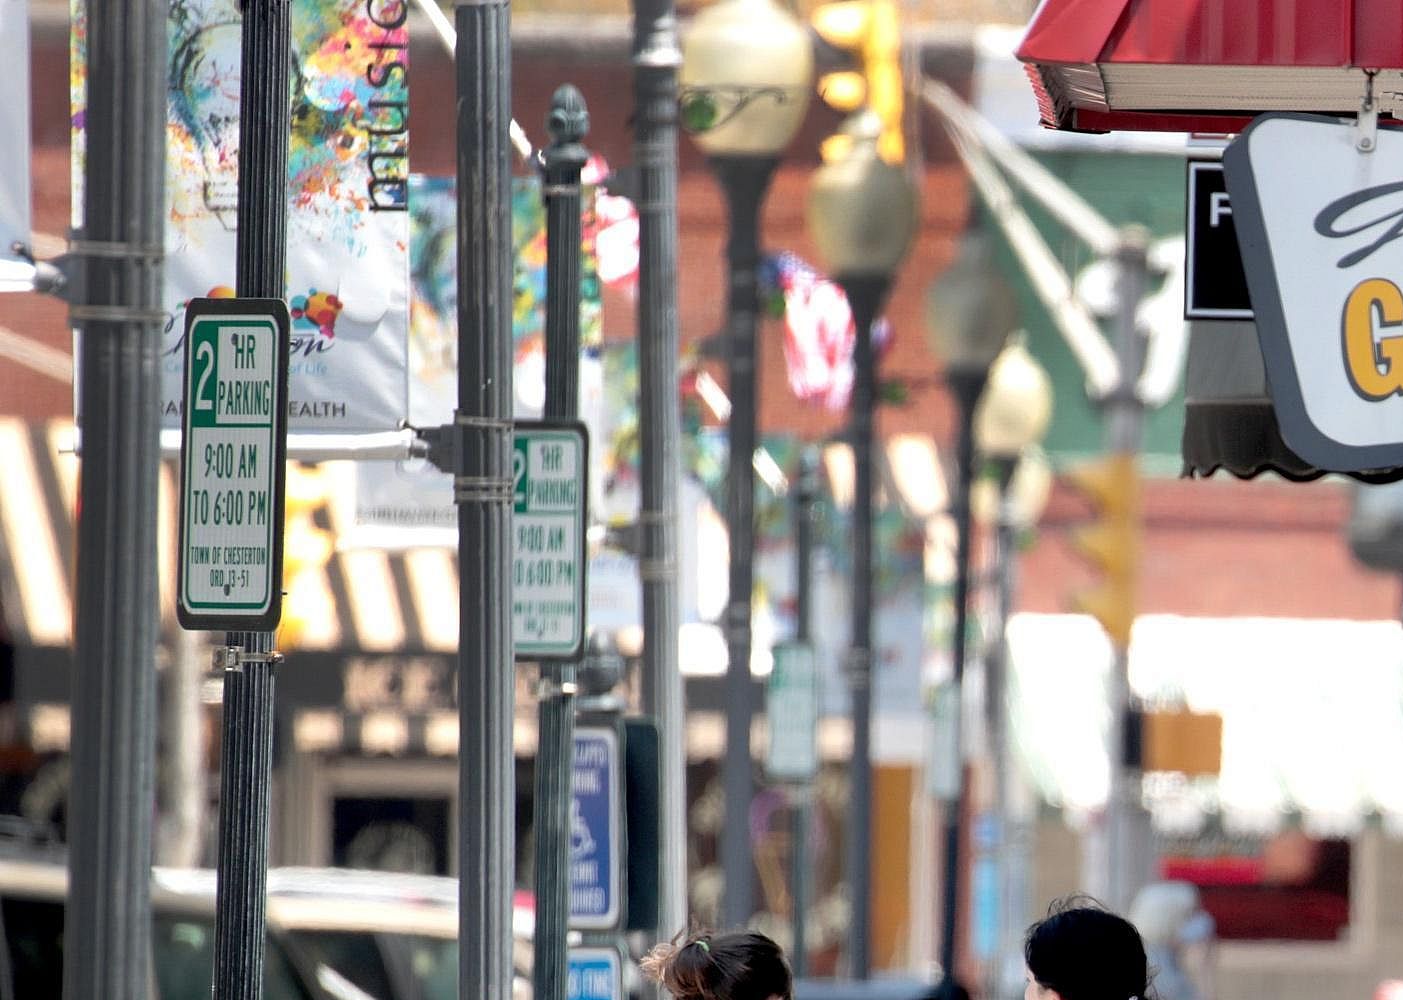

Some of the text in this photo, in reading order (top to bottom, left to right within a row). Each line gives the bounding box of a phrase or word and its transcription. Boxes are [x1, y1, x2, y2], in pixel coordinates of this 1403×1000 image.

[195, 340, 214, 411] 2
[234, 334, 256, 369] HR
[217, 380, 270, 416] PARKING
[288, 402, 346, 418] EALTH
[204, 442, 257, 479] 9:00 AM
[193, 489, 266, 526] TO 6:00 PM
[528, 479, 576, 506] PARKING
[191, 546, 266, 565] TOWN OF CHESTERTON
[210, 568, 224, 588] ORD
